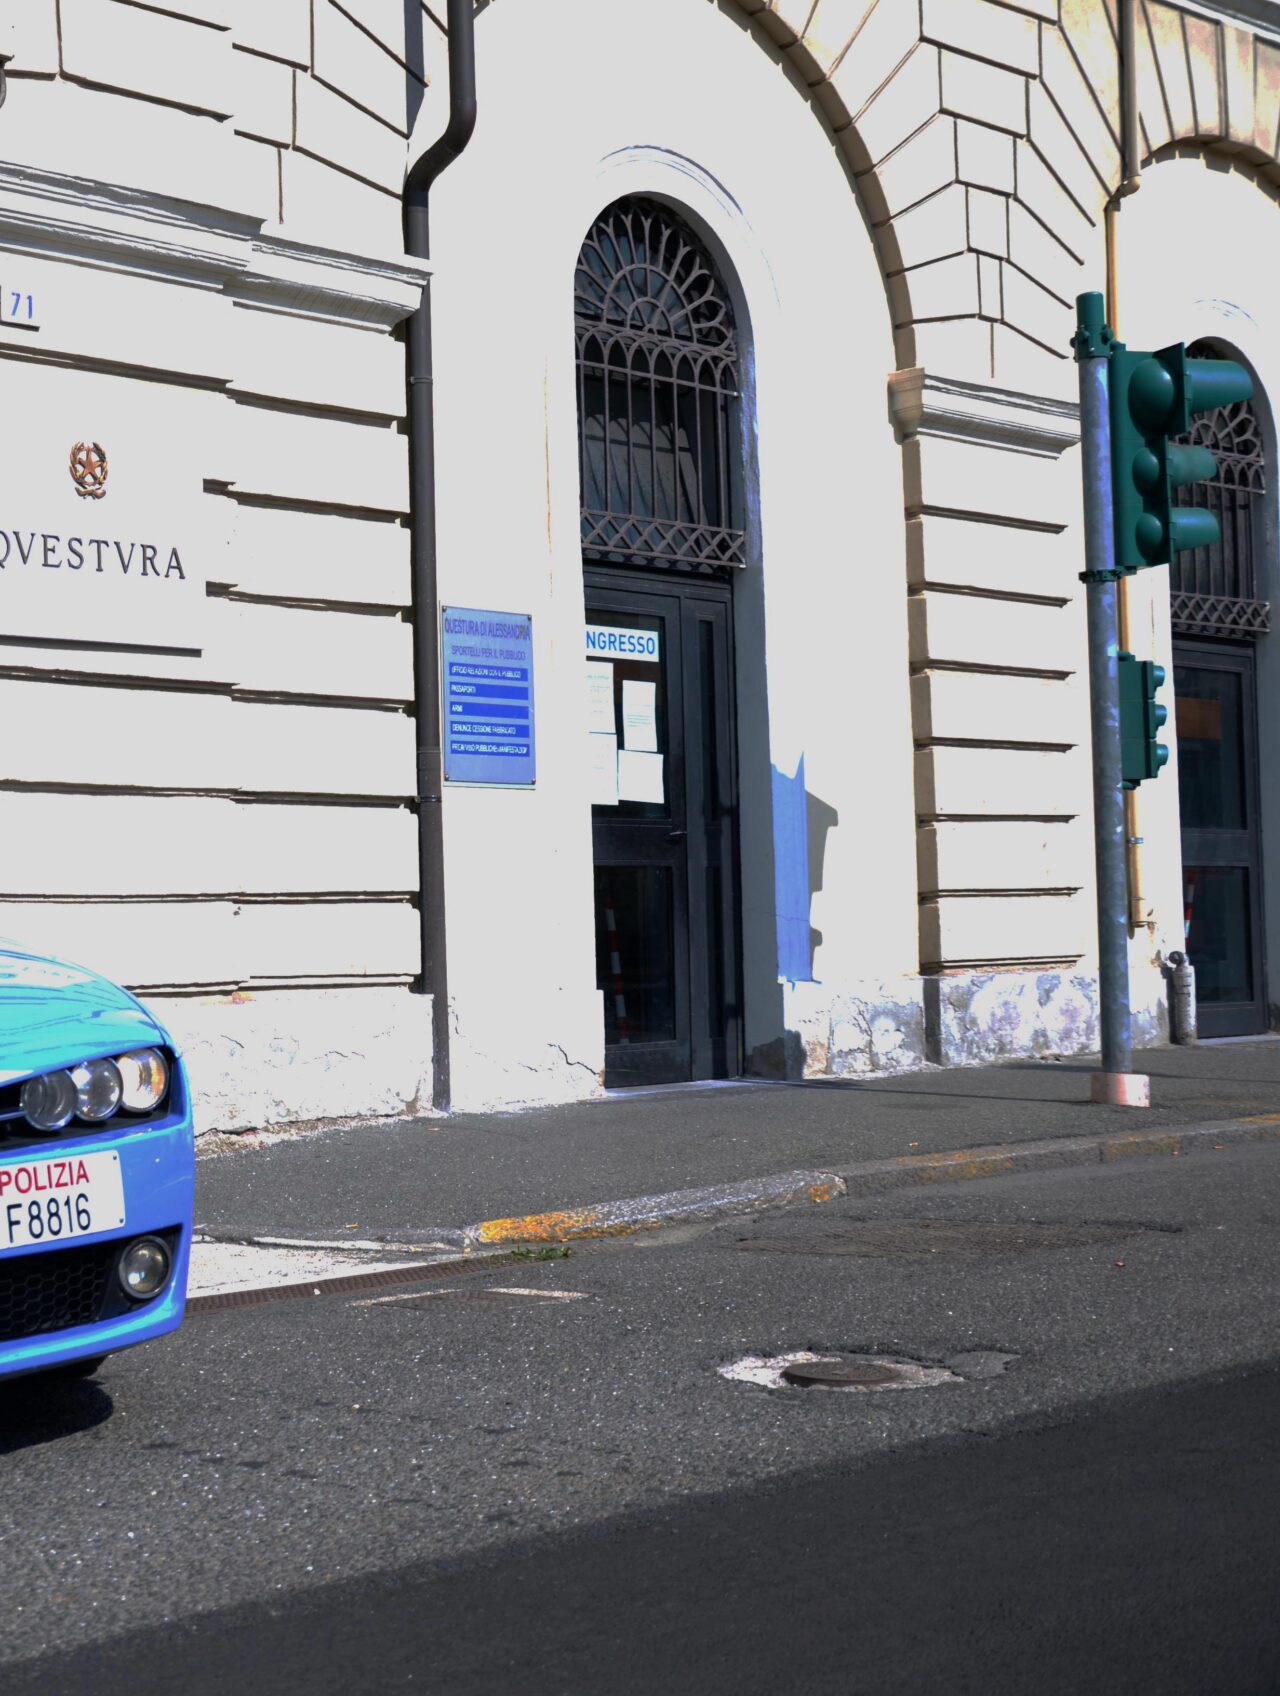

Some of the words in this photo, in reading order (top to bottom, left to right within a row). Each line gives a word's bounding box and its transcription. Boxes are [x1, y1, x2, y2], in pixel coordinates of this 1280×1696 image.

[10, 292, 33, 319] 71
[445, 617, 479, 636] QUESTURA
[586, 630, 656, 655] NGRESSO
[6, 1193, 92, 1244] F8816
